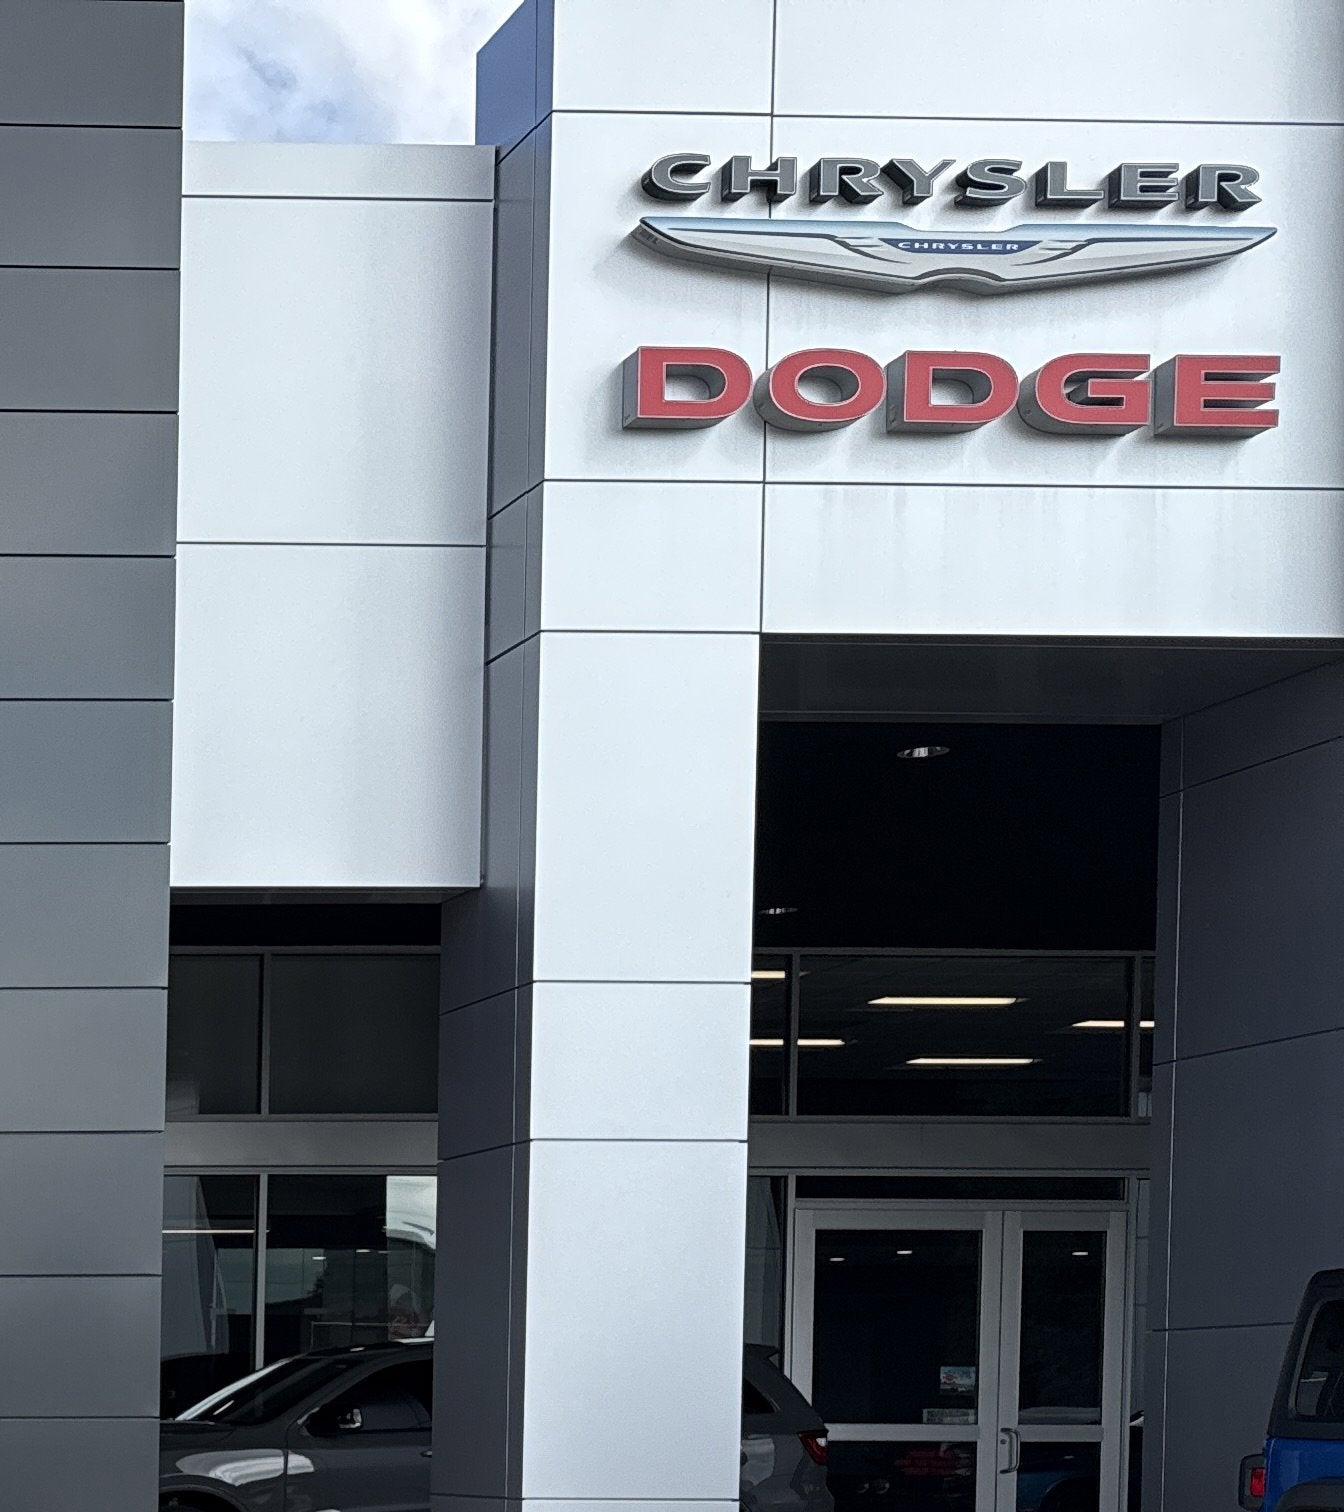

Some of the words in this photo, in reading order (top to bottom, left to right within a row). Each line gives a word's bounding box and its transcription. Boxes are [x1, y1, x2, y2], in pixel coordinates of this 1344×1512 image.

[641, 152, 1262, 211] CHRYSLER
[897, 241, 1019, 251] CHRYSLER
[622, 345, 1282, 436] DODGE
